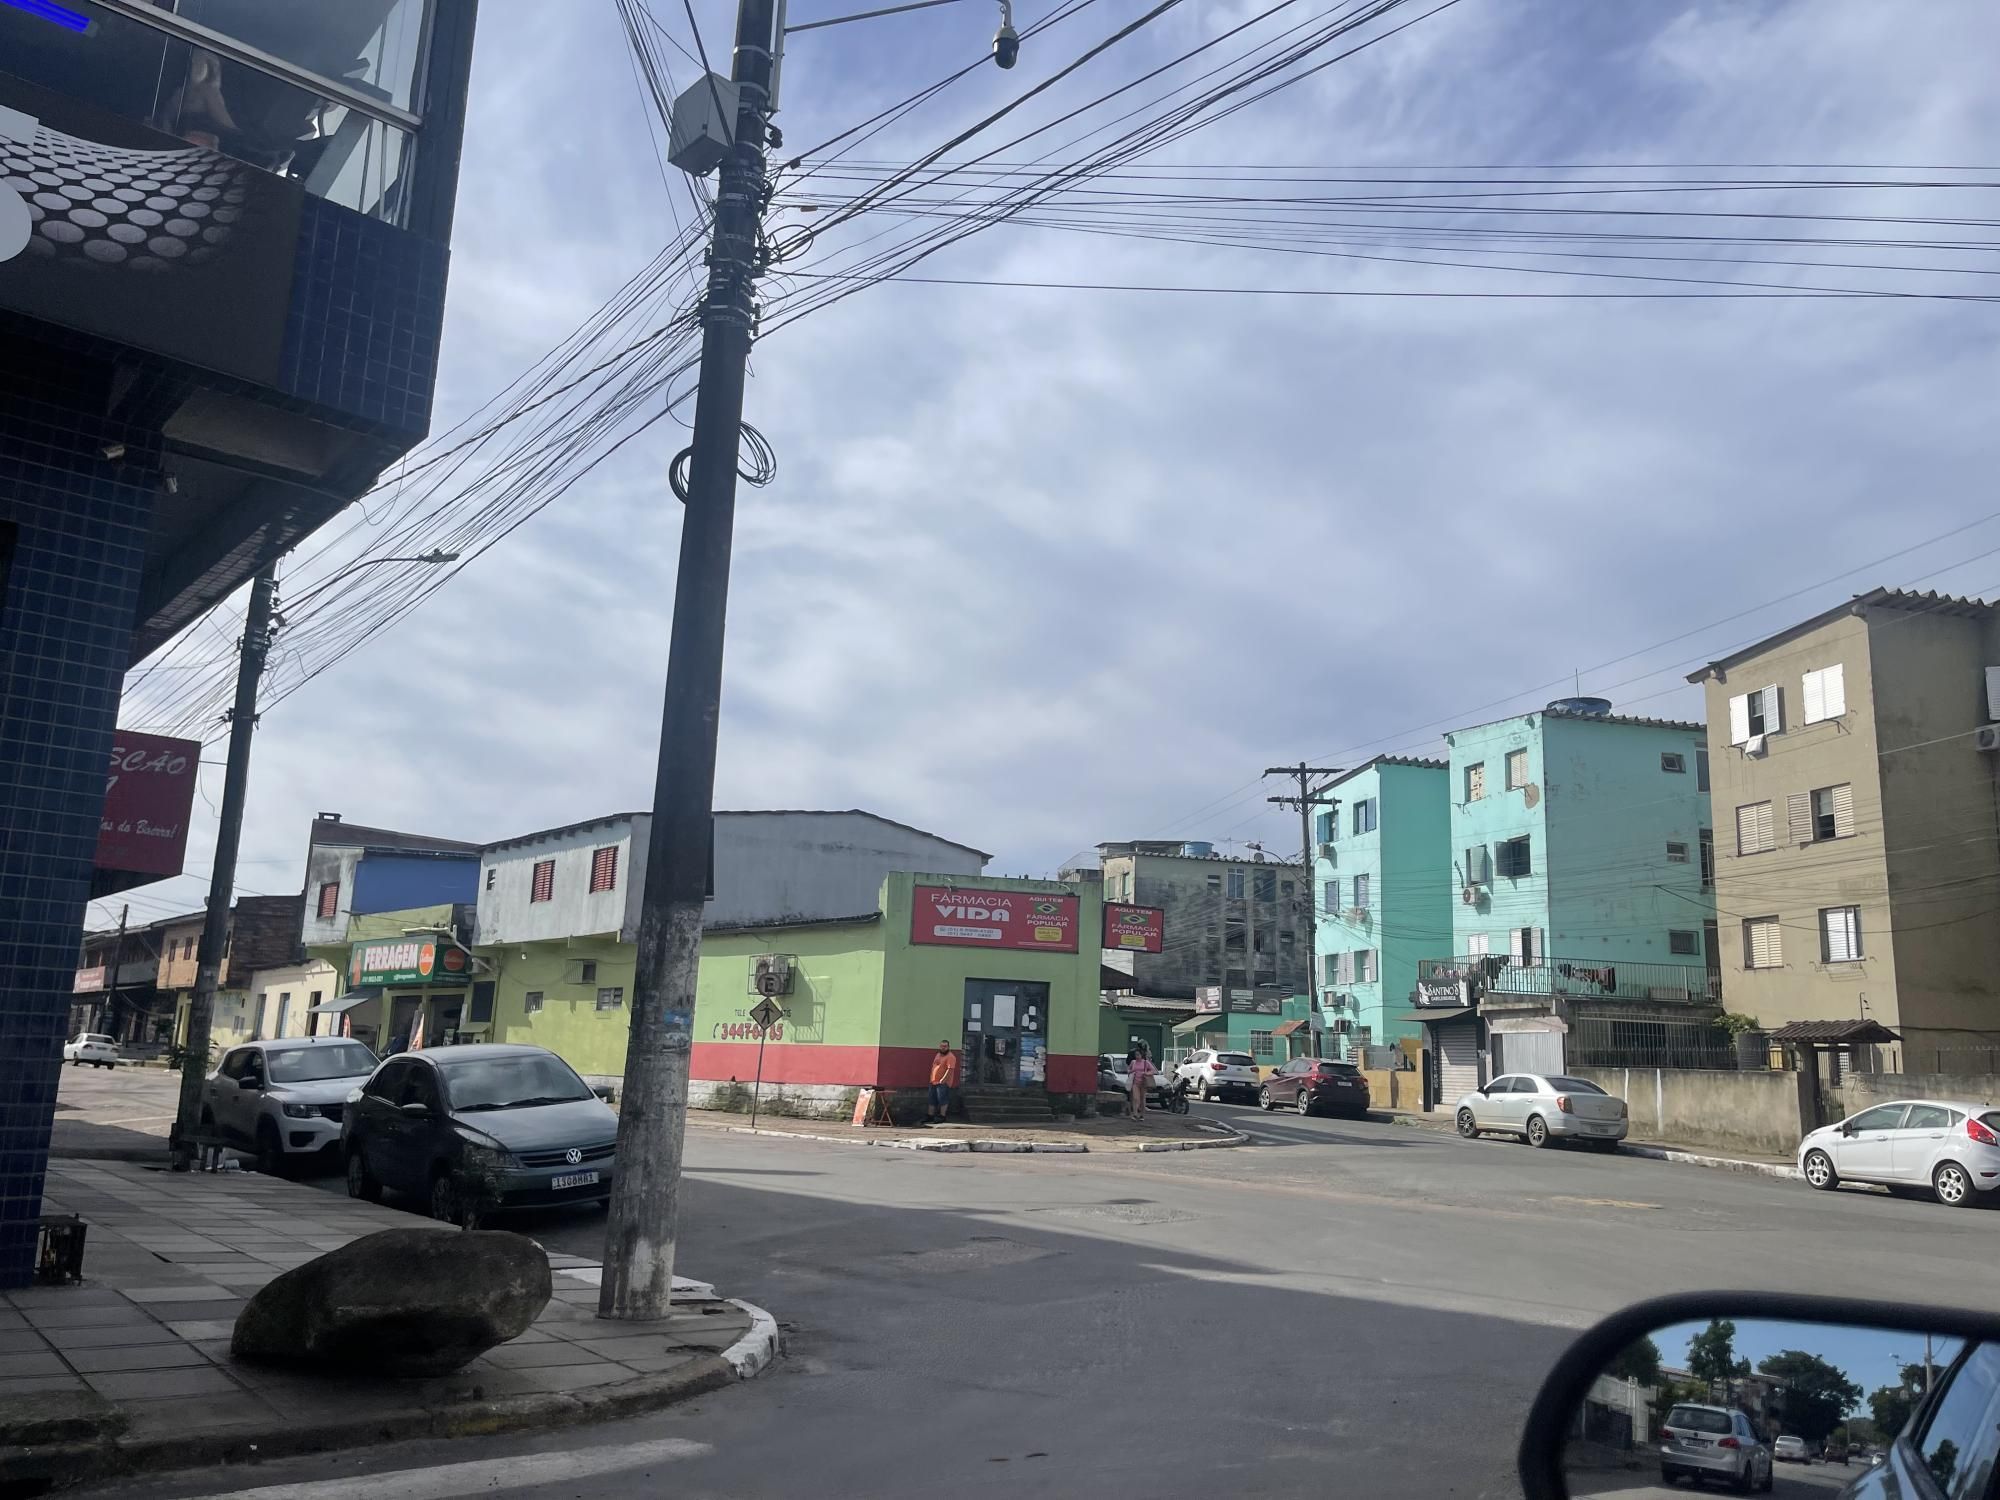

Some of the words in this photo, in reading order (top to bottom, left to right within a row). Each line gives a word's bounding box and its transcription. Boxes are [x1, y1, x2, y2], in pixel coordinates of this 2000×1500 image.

[936, 904, 1010, 922] VIDA
[1112, 929, 1157, 938] POPULAR
[364, 943, 419, 971] FERRAGEM
